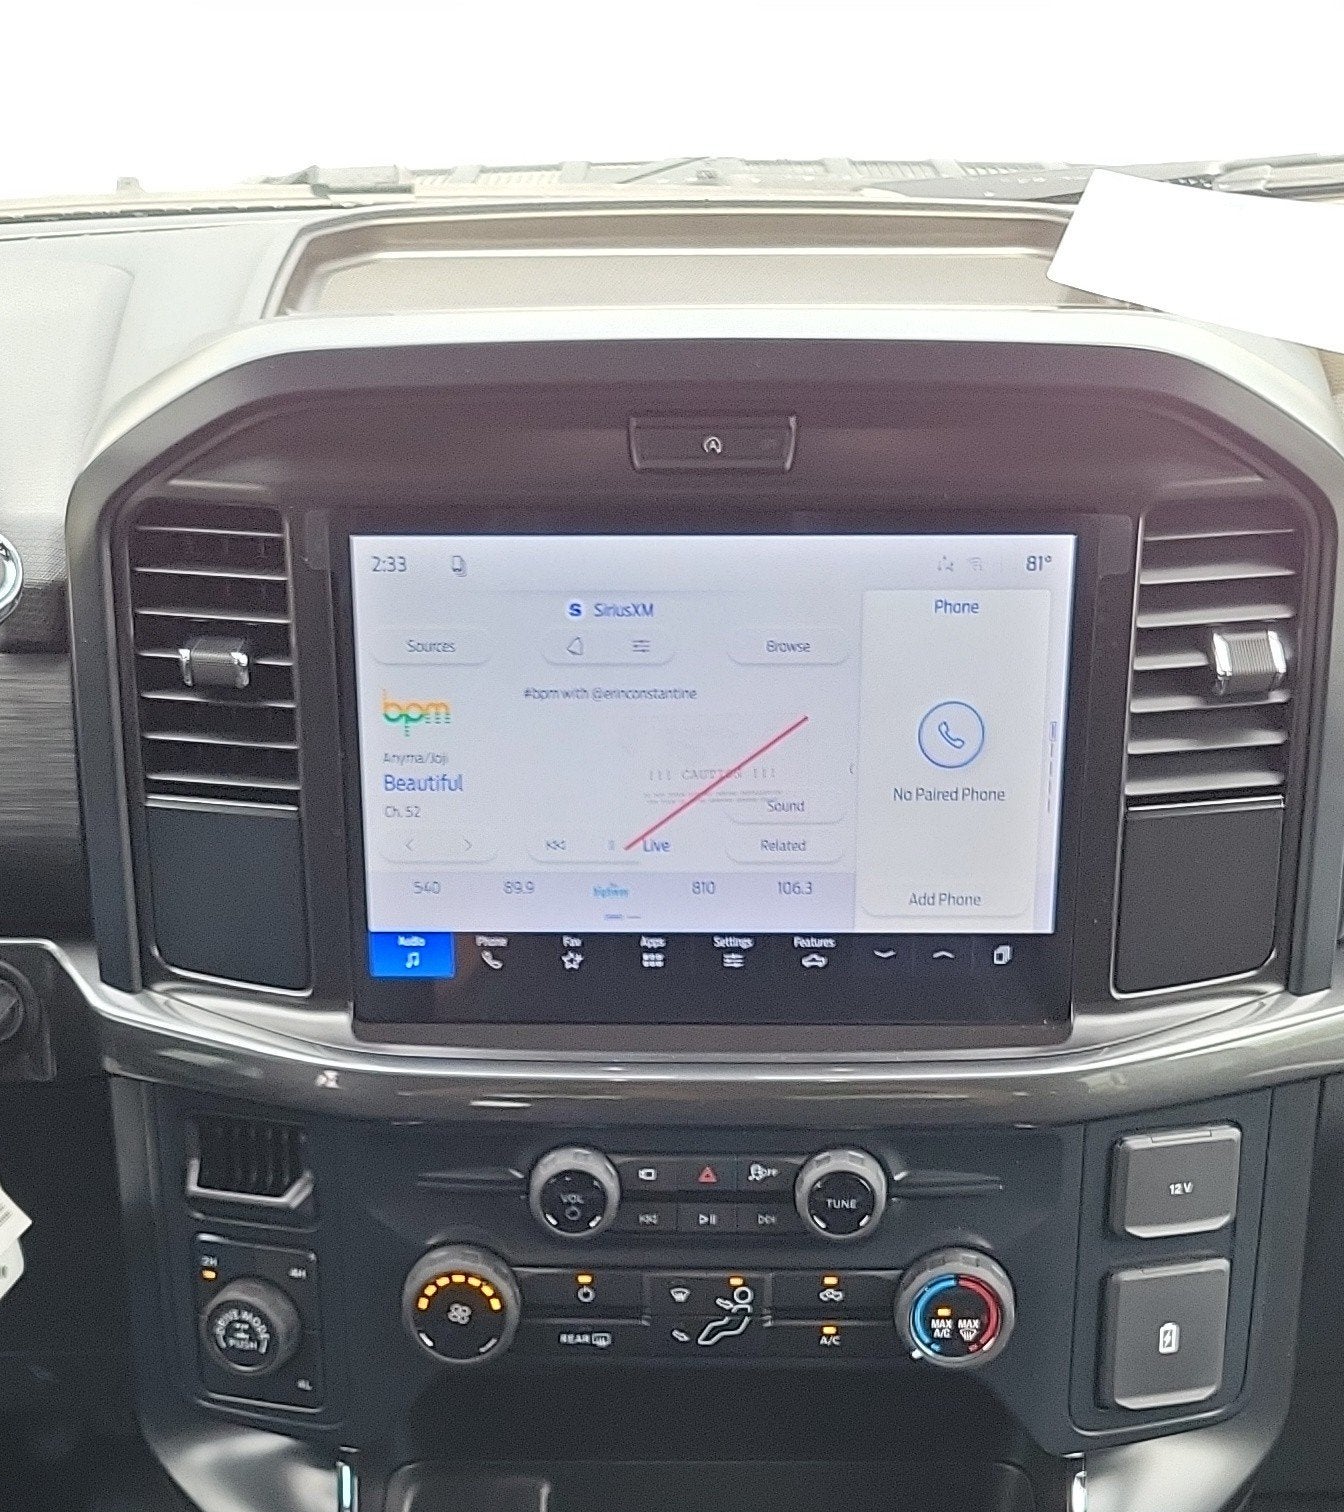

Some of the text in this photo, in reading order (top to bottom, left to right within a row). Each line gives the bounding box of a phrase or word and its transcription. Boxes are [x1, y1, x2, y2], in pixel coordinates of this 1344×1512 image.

[371, 556, 407, 573] 2:33
[593, 602, 654, 618] SiriusXM
[933, 599, 980, 615] Phone
[406, 640, 457, 653] Sources
[765, 640, 811, 654] Browse
[562, 687, 590, 700] with
[383, 690, 451, 737] bpm
[682, 769, 743, 781] CAUTN
[383, 774, 464, 792] Beautiful
[893, 787, 1006, 801] No Paired Phone
[384, 805, 422, 819] Ch. 52
[766, 800, 805, 813] Sound
[642, 838, 672, 852] Live
[760, 838, 807, 853] Related
[413, 881, 441, 895] 540
[503, 881, 536, 895] 89.9
[691, 881, 716, 895] 810
[777, 881, 814, 895] 106.3
[907, 892, 982, 907] Add Phone
[474, 936, 508, 948] Phone
[638, 936, 666, 949] Apps
[712, 935, 754, 950] Settings
[793, 935, 837, 949] Features
[825, 1198, 858, 1210] TUNE
[931, 1318, 952, 1329] MAX
[958, 1318, 979, 1329] MAX
[559, 1333, 590, 1344] REAR
[933, 1328, 952, 1339] A/C
[819, 1336, 840, 1346] A/C
